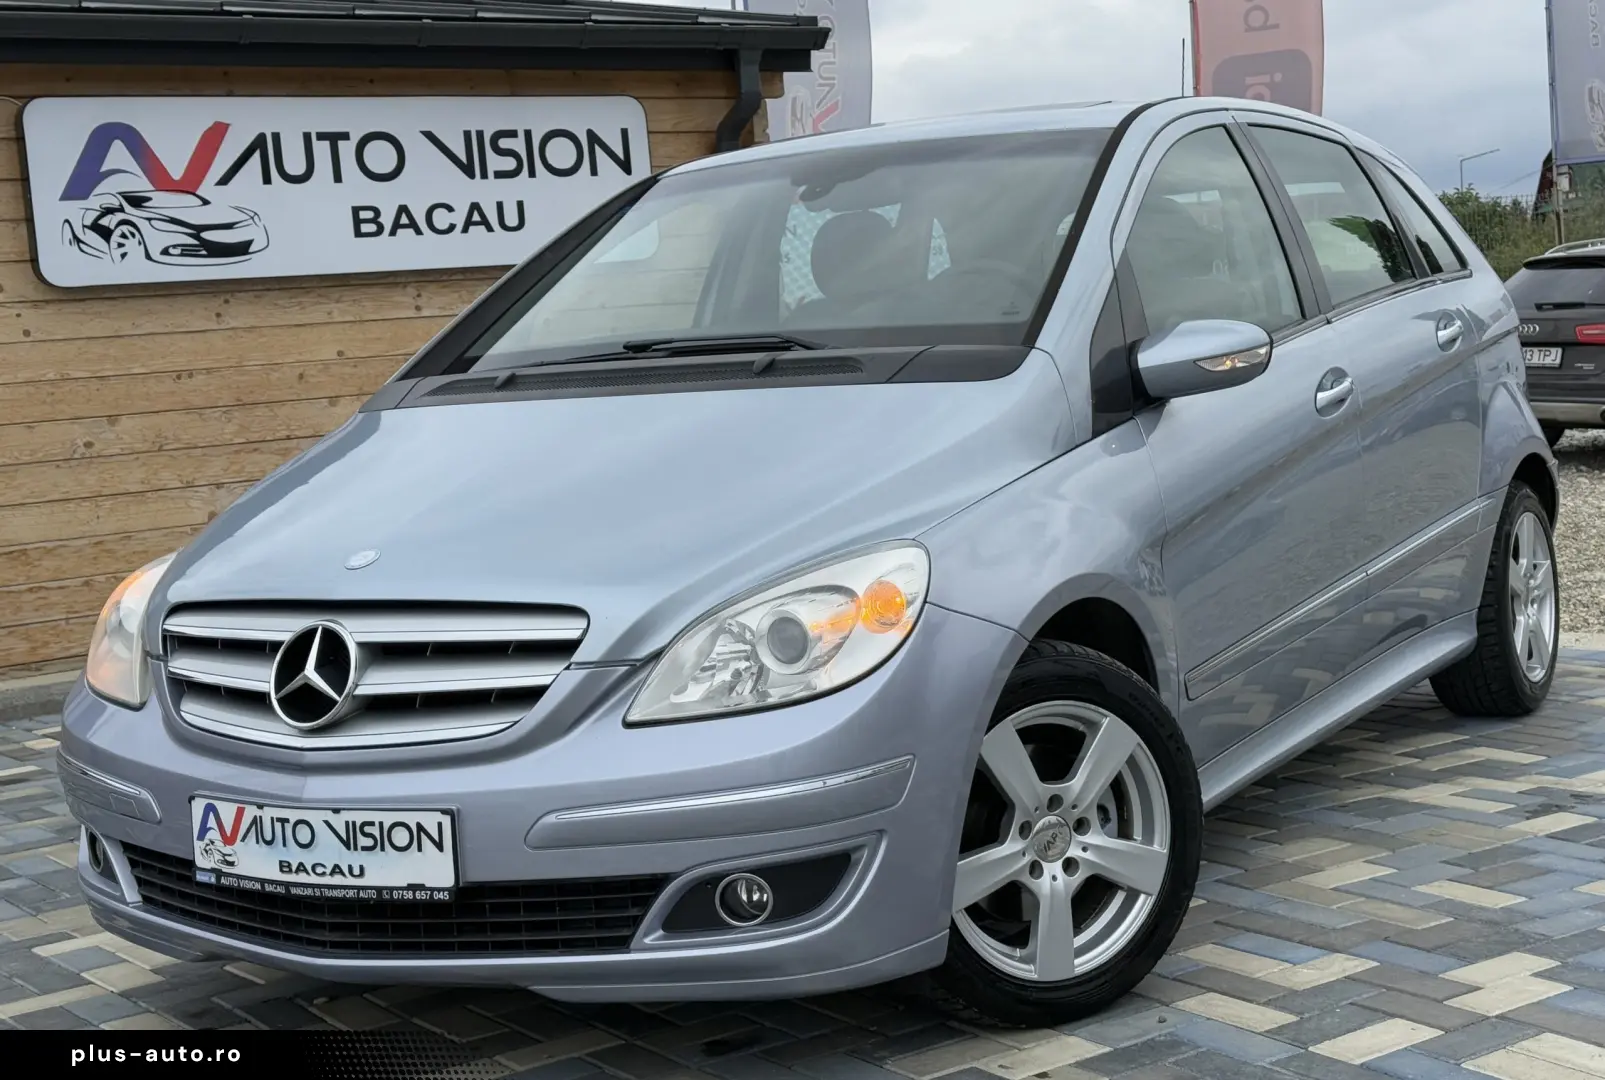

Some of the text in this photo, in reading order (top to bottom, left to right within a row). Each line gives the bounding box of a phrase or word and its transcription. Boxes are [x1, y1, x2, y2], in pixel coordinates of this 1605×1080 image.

[214, 127, 633, 187] AUTO VISION
[351, 200, 526, 239] BACAU
[1537, 348, 1559, 362] TPJ
[240, 814, 445, 853] AUTO VISION
[278, 859, 366, 879] BACAU
[220, 875, 239, 887] AUTO
[239, 878, 262, 891] VISION
[264, 882, 285, 894] BACAU
[289, 885, 314, 897] VANZARI
[321, 888, 358, 899] TRANSPORT
[359, 890, 377, 899] AUTO
[392, 890, 414, 900] 0758
[415, 890, 431, 900] 657
[433, 891, 450, 901] 045
